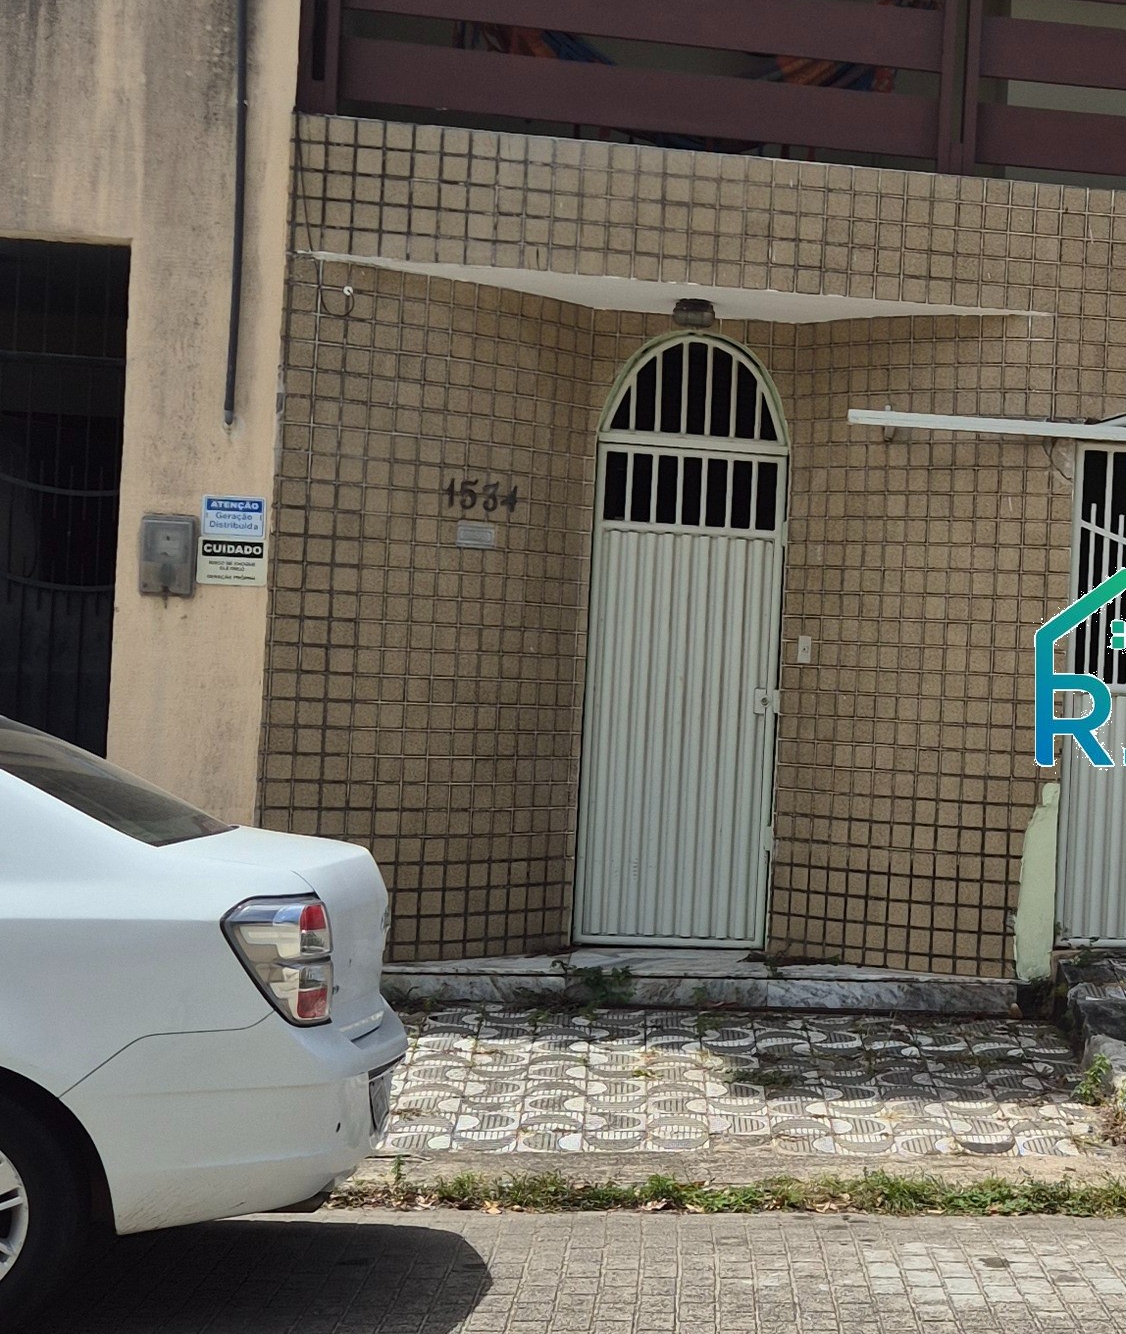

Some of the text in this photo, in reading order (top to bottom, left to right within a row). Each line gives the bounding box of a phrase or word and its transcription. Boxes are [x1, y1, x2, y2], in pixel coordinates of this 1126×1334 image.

[444, 478, 518, 513] 1534
[210, 500, 260, 510] ATENÇÃO
[215, 512, 253, 521] Geração
[203, 543, 262, 555] CUIDADO
